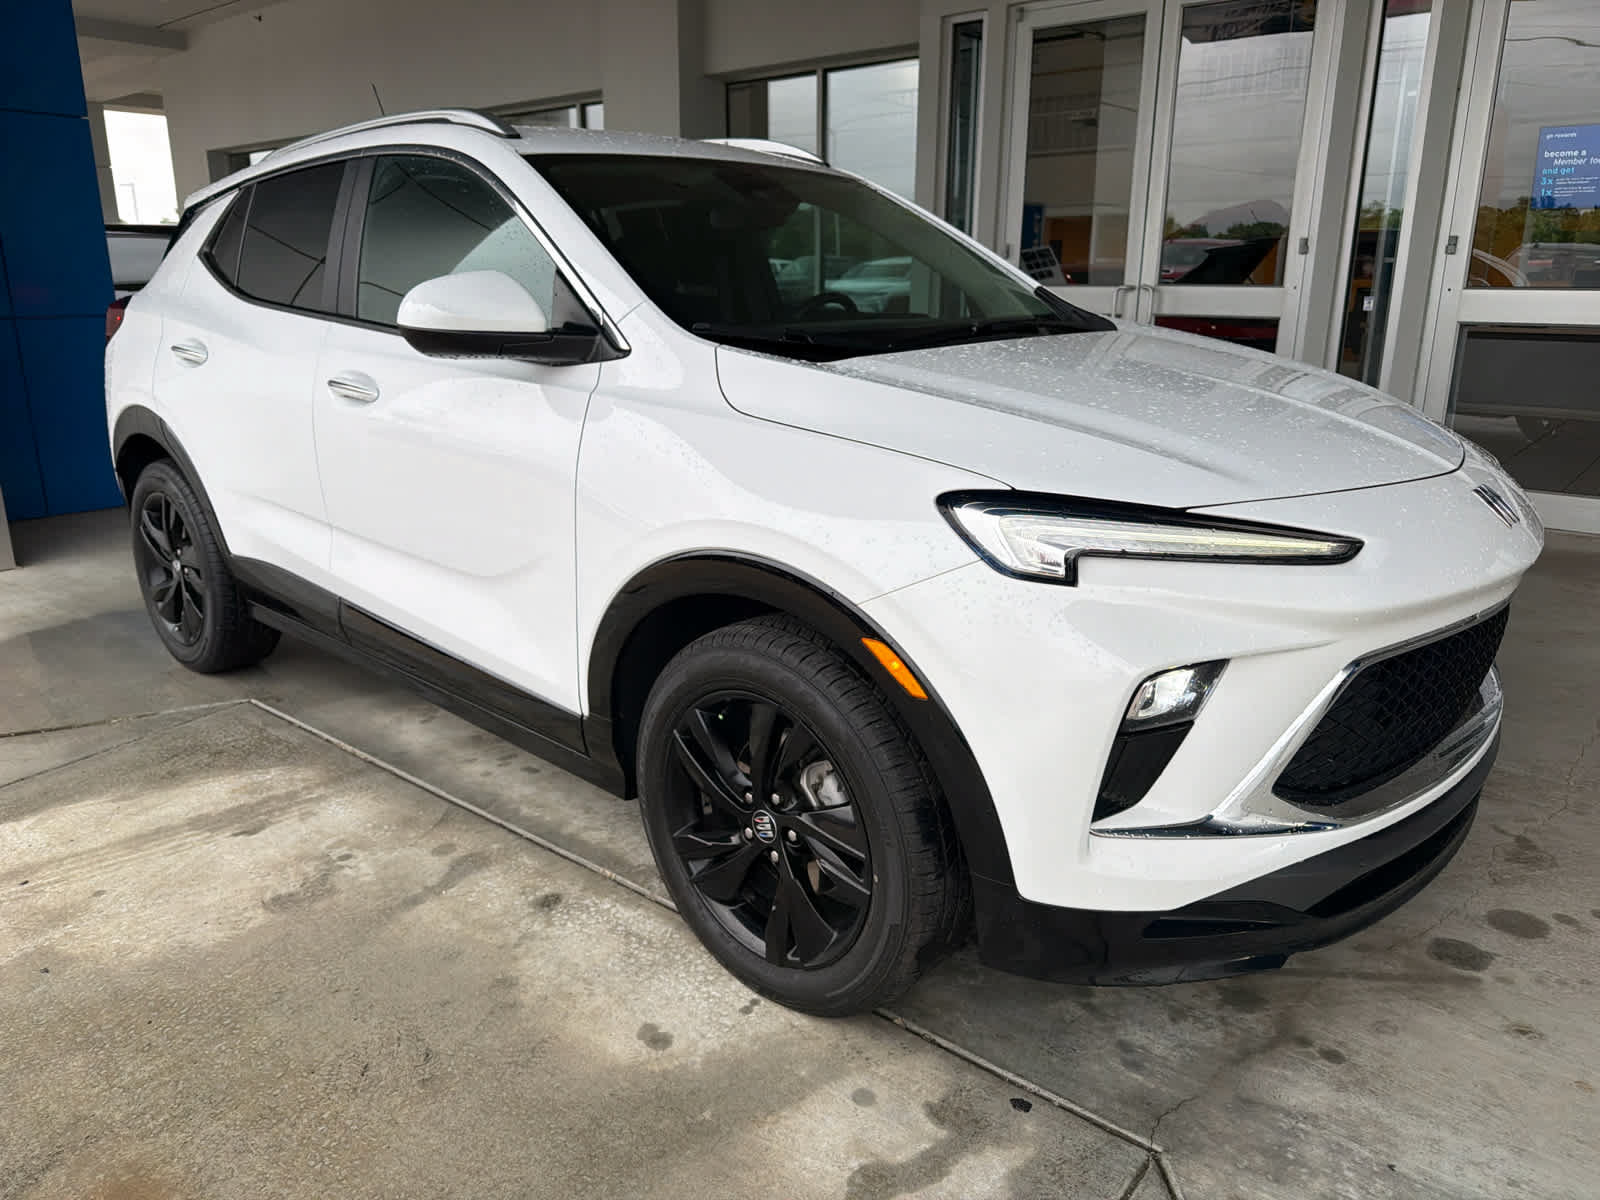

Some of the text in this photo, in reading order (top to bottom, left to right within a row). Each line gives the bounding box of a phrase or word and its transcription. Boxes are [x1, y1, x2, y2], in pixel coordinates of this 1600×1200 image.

[1544, 150, 1579, 158] become
[1553, 157, 1587, 166] Member
[1542, 167, 1574, 175] and get
